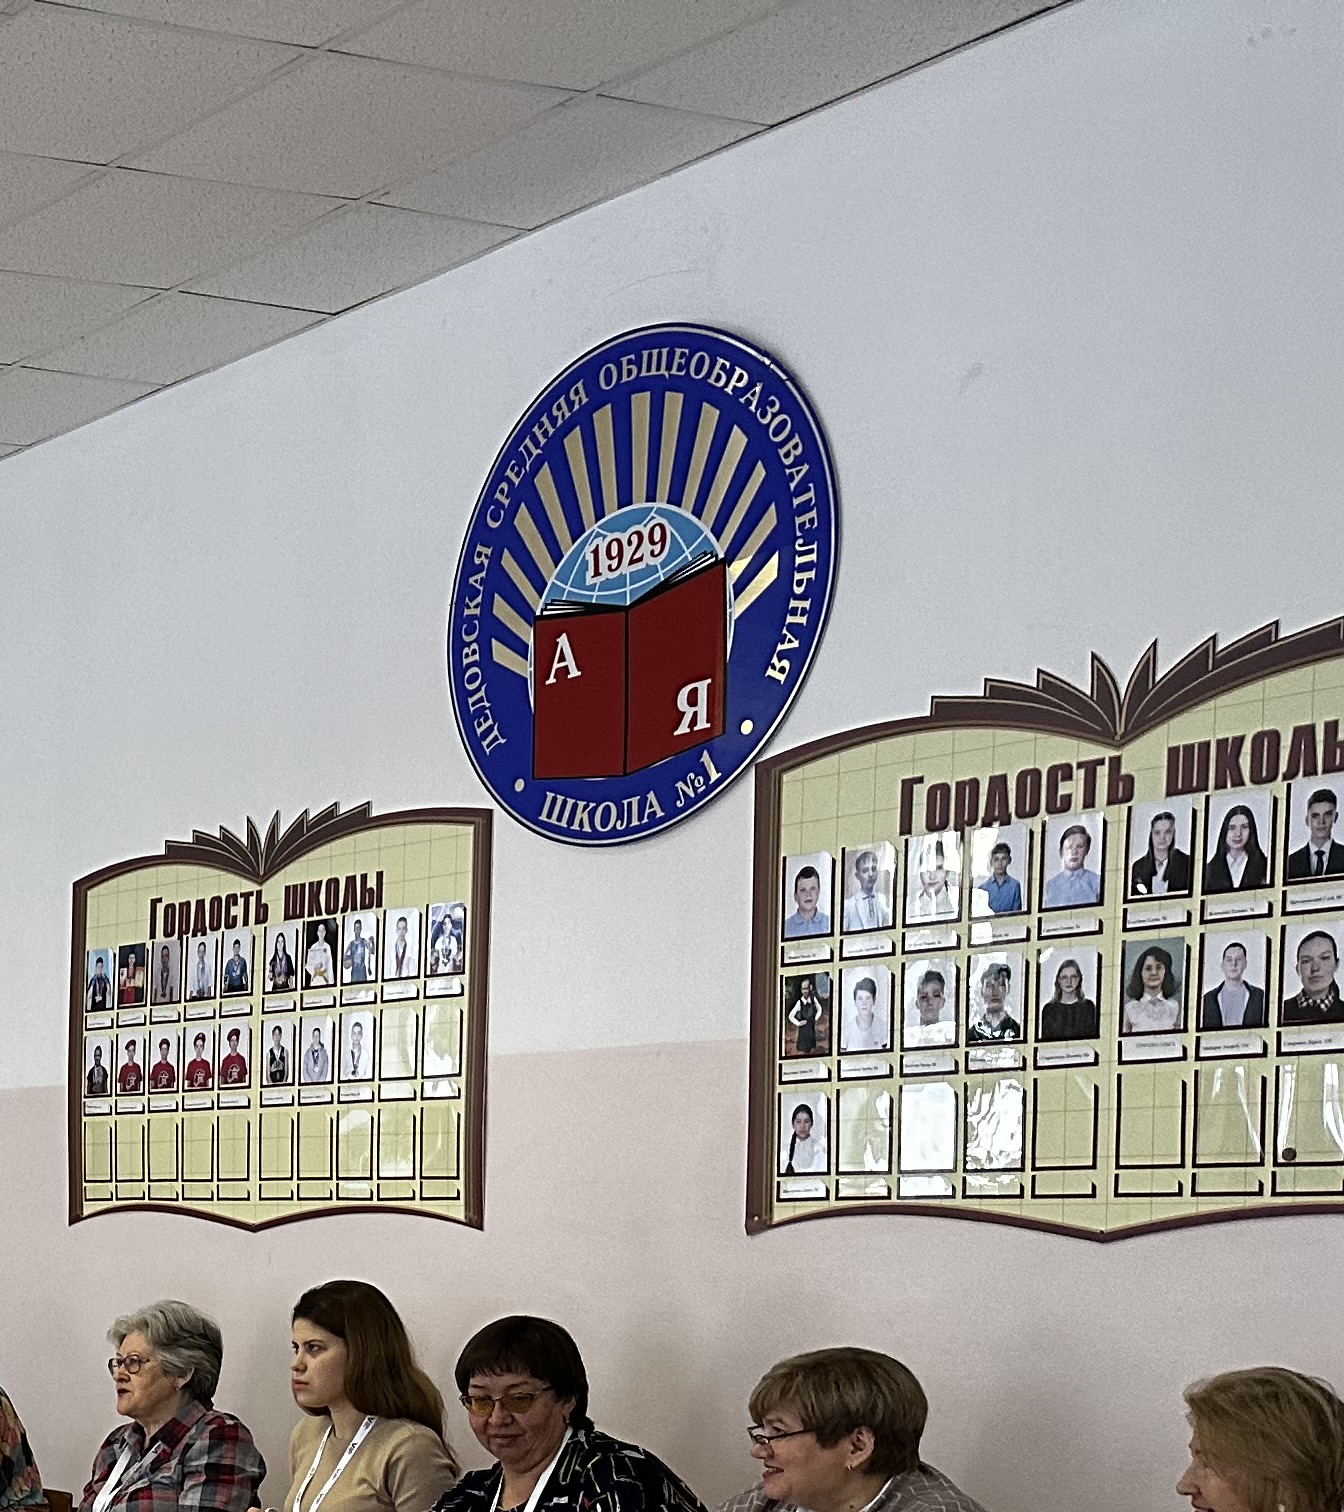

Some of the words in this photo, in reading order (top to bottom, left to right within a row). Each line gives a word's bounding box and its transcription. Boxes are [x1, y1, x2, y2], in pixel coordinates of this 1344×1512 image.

[461, 542, 507, 755] ДЕДОВСКАЯ
[487, 380, 590, 530] СРЕДНЯЯ
[598, 346, 817, 685] ОБЩЕОБРАЗОВАТЕЛЬНАЯ
[588, 522, 668, 580] 1929
[545, 633, 582, 685] А
[673, 678, 712, 737] Я
[538, 790, 666, 833] ШКОЛА
